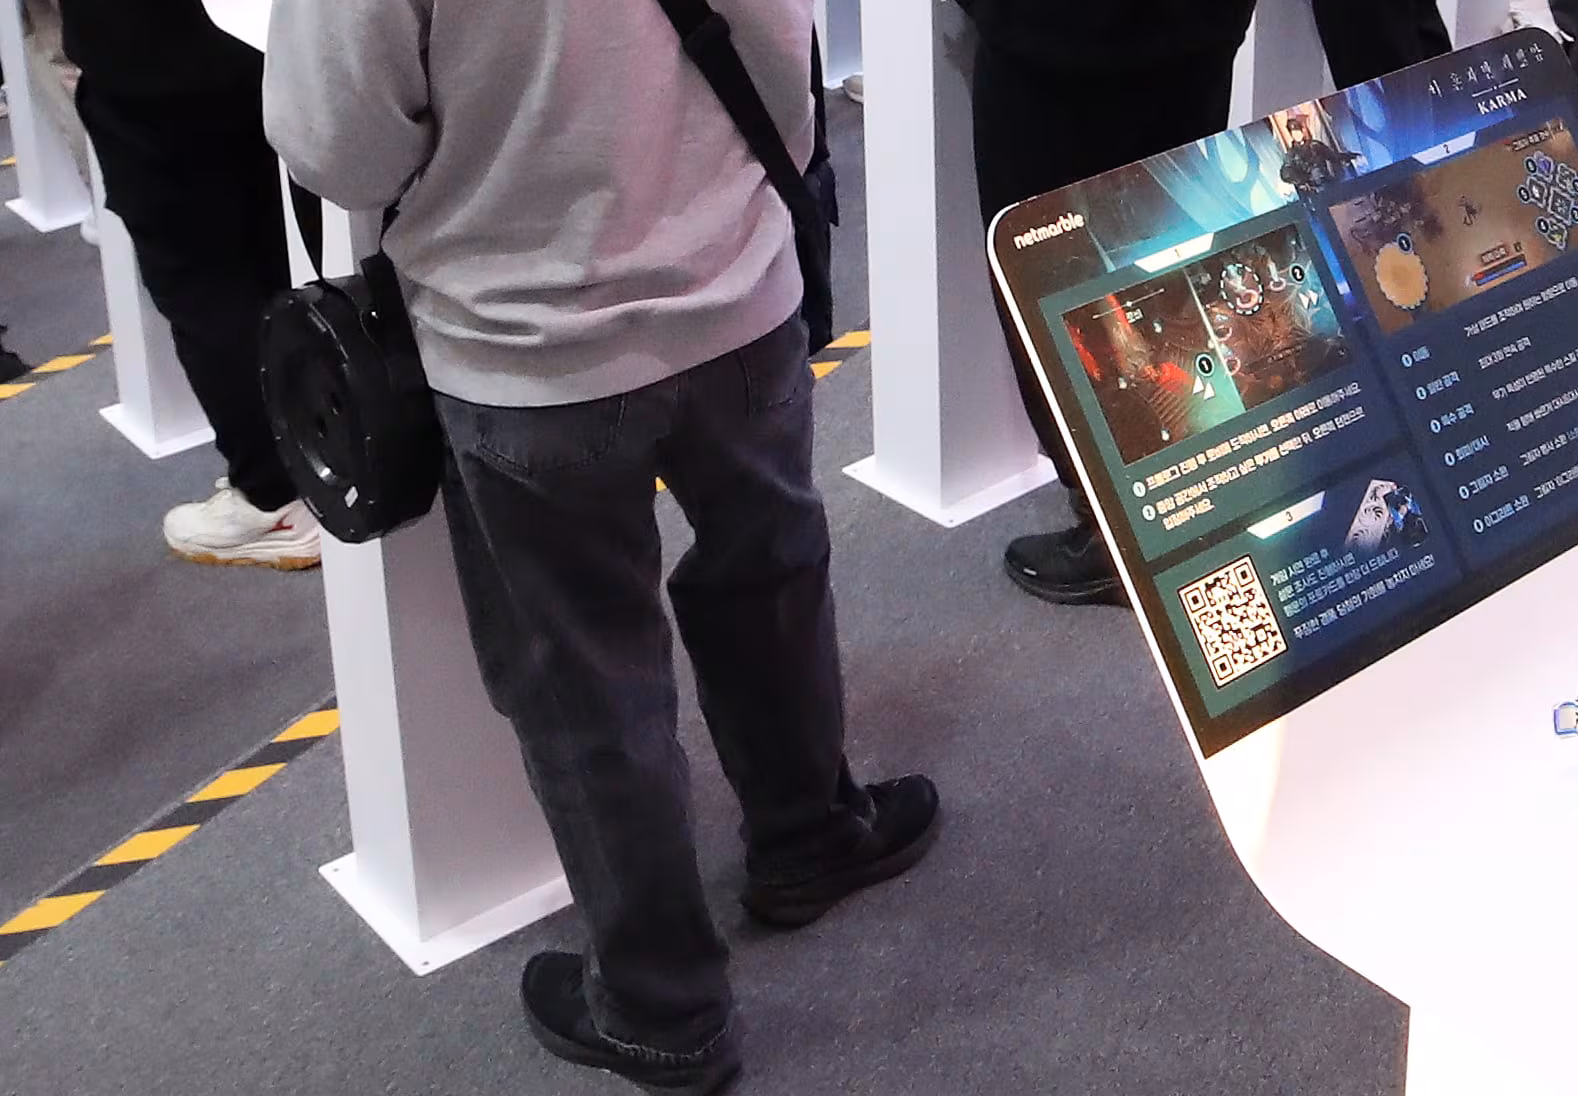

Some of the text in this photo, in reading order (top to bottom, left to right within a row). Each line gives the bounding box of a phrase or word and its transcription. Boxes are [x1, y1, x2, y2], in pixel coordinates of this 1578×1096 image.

[1477, 87, 1526, 114] KARMA
[1011, 210, 1085, 249] netmarble
[1283, 510, 1294, 523] 3
